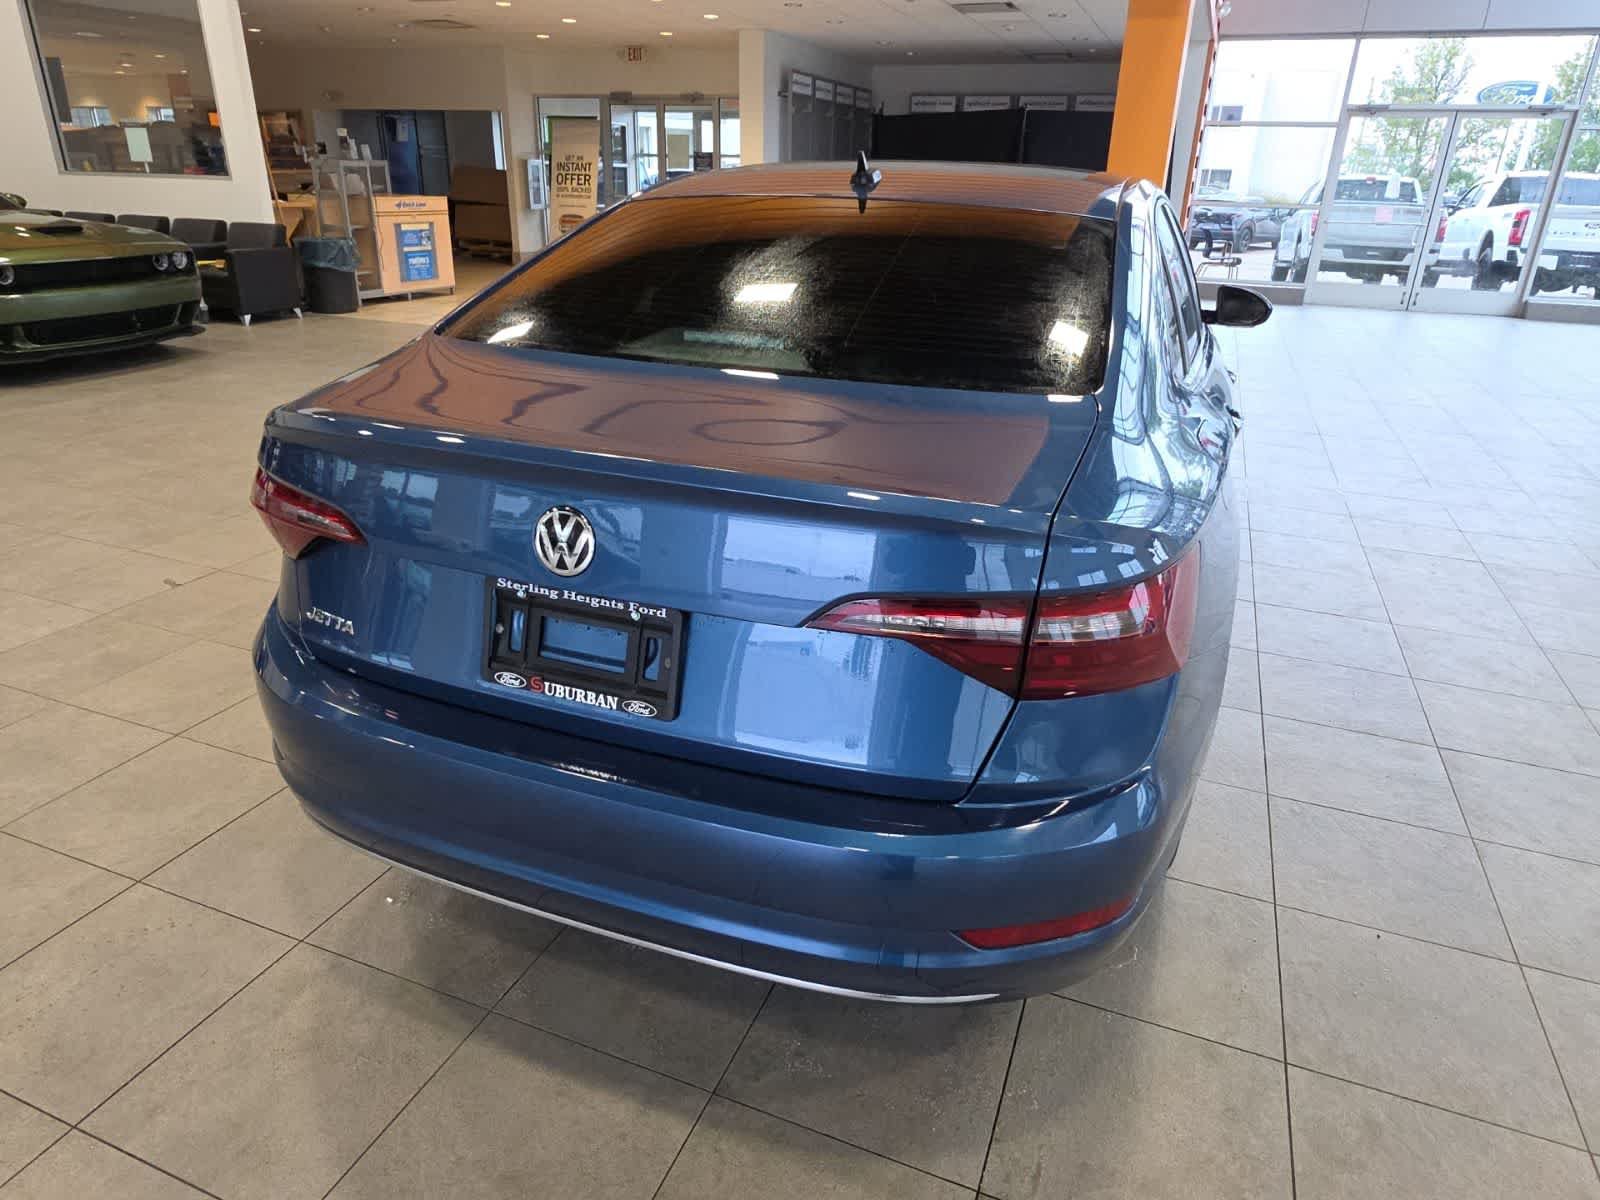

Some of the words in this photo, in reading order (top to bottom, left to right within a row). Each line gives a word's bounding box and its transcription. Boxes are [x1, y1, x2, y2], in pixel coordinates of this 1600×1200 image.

[628, 47, 642, 62] EXIT
[556, 161, 592, 172] INSTANT
[556, 172, 592, 187] OFFER
[496, 577, 559, 600] Sterling
[562, 589, 625, 611] Heights
[628, 601, 667, 619] Ford
[306, 606, 354, 636] JETTA
[529, 676, 618, 711] SUBURBAN
